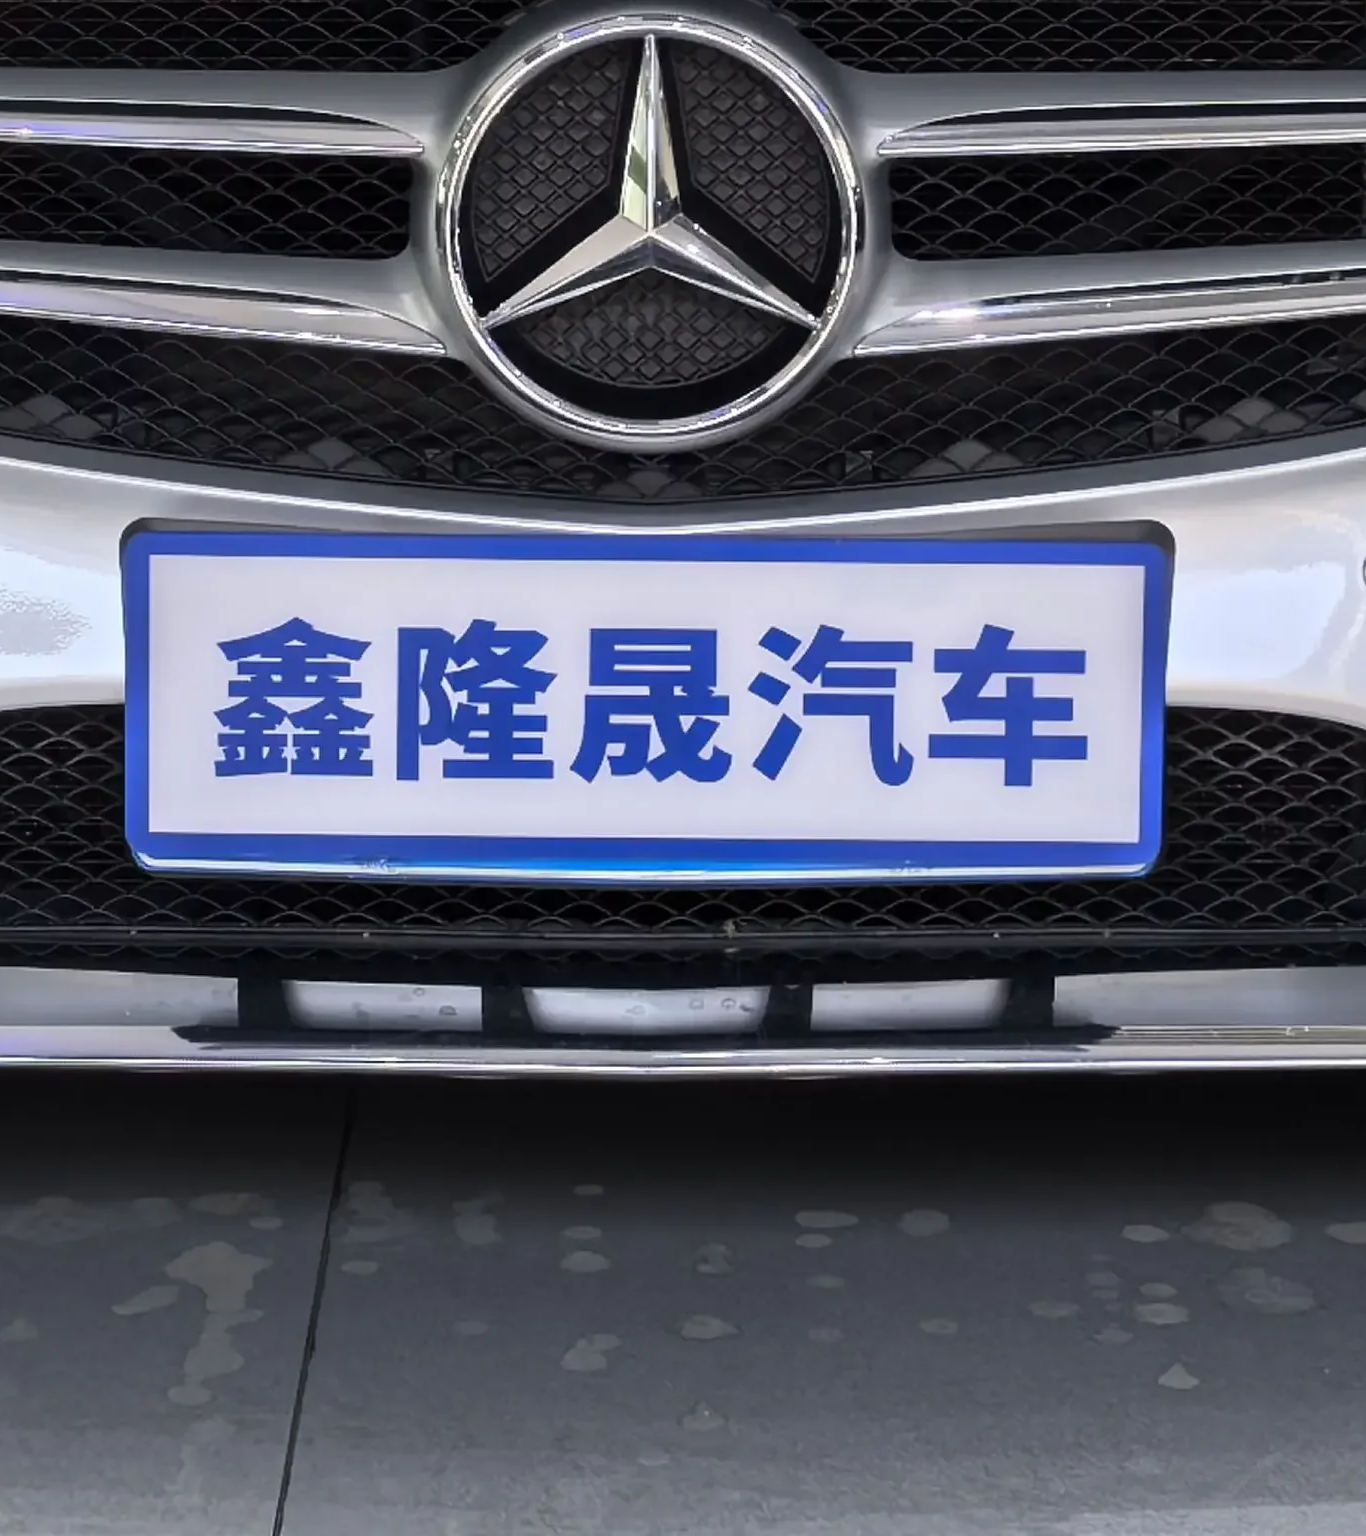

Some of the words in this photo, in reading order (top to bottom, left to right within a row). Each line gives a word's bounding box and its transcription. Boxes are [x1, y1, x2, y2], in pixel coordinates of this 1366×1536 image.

[214, 617, 1088, 787] 鑫隆晟汽车
